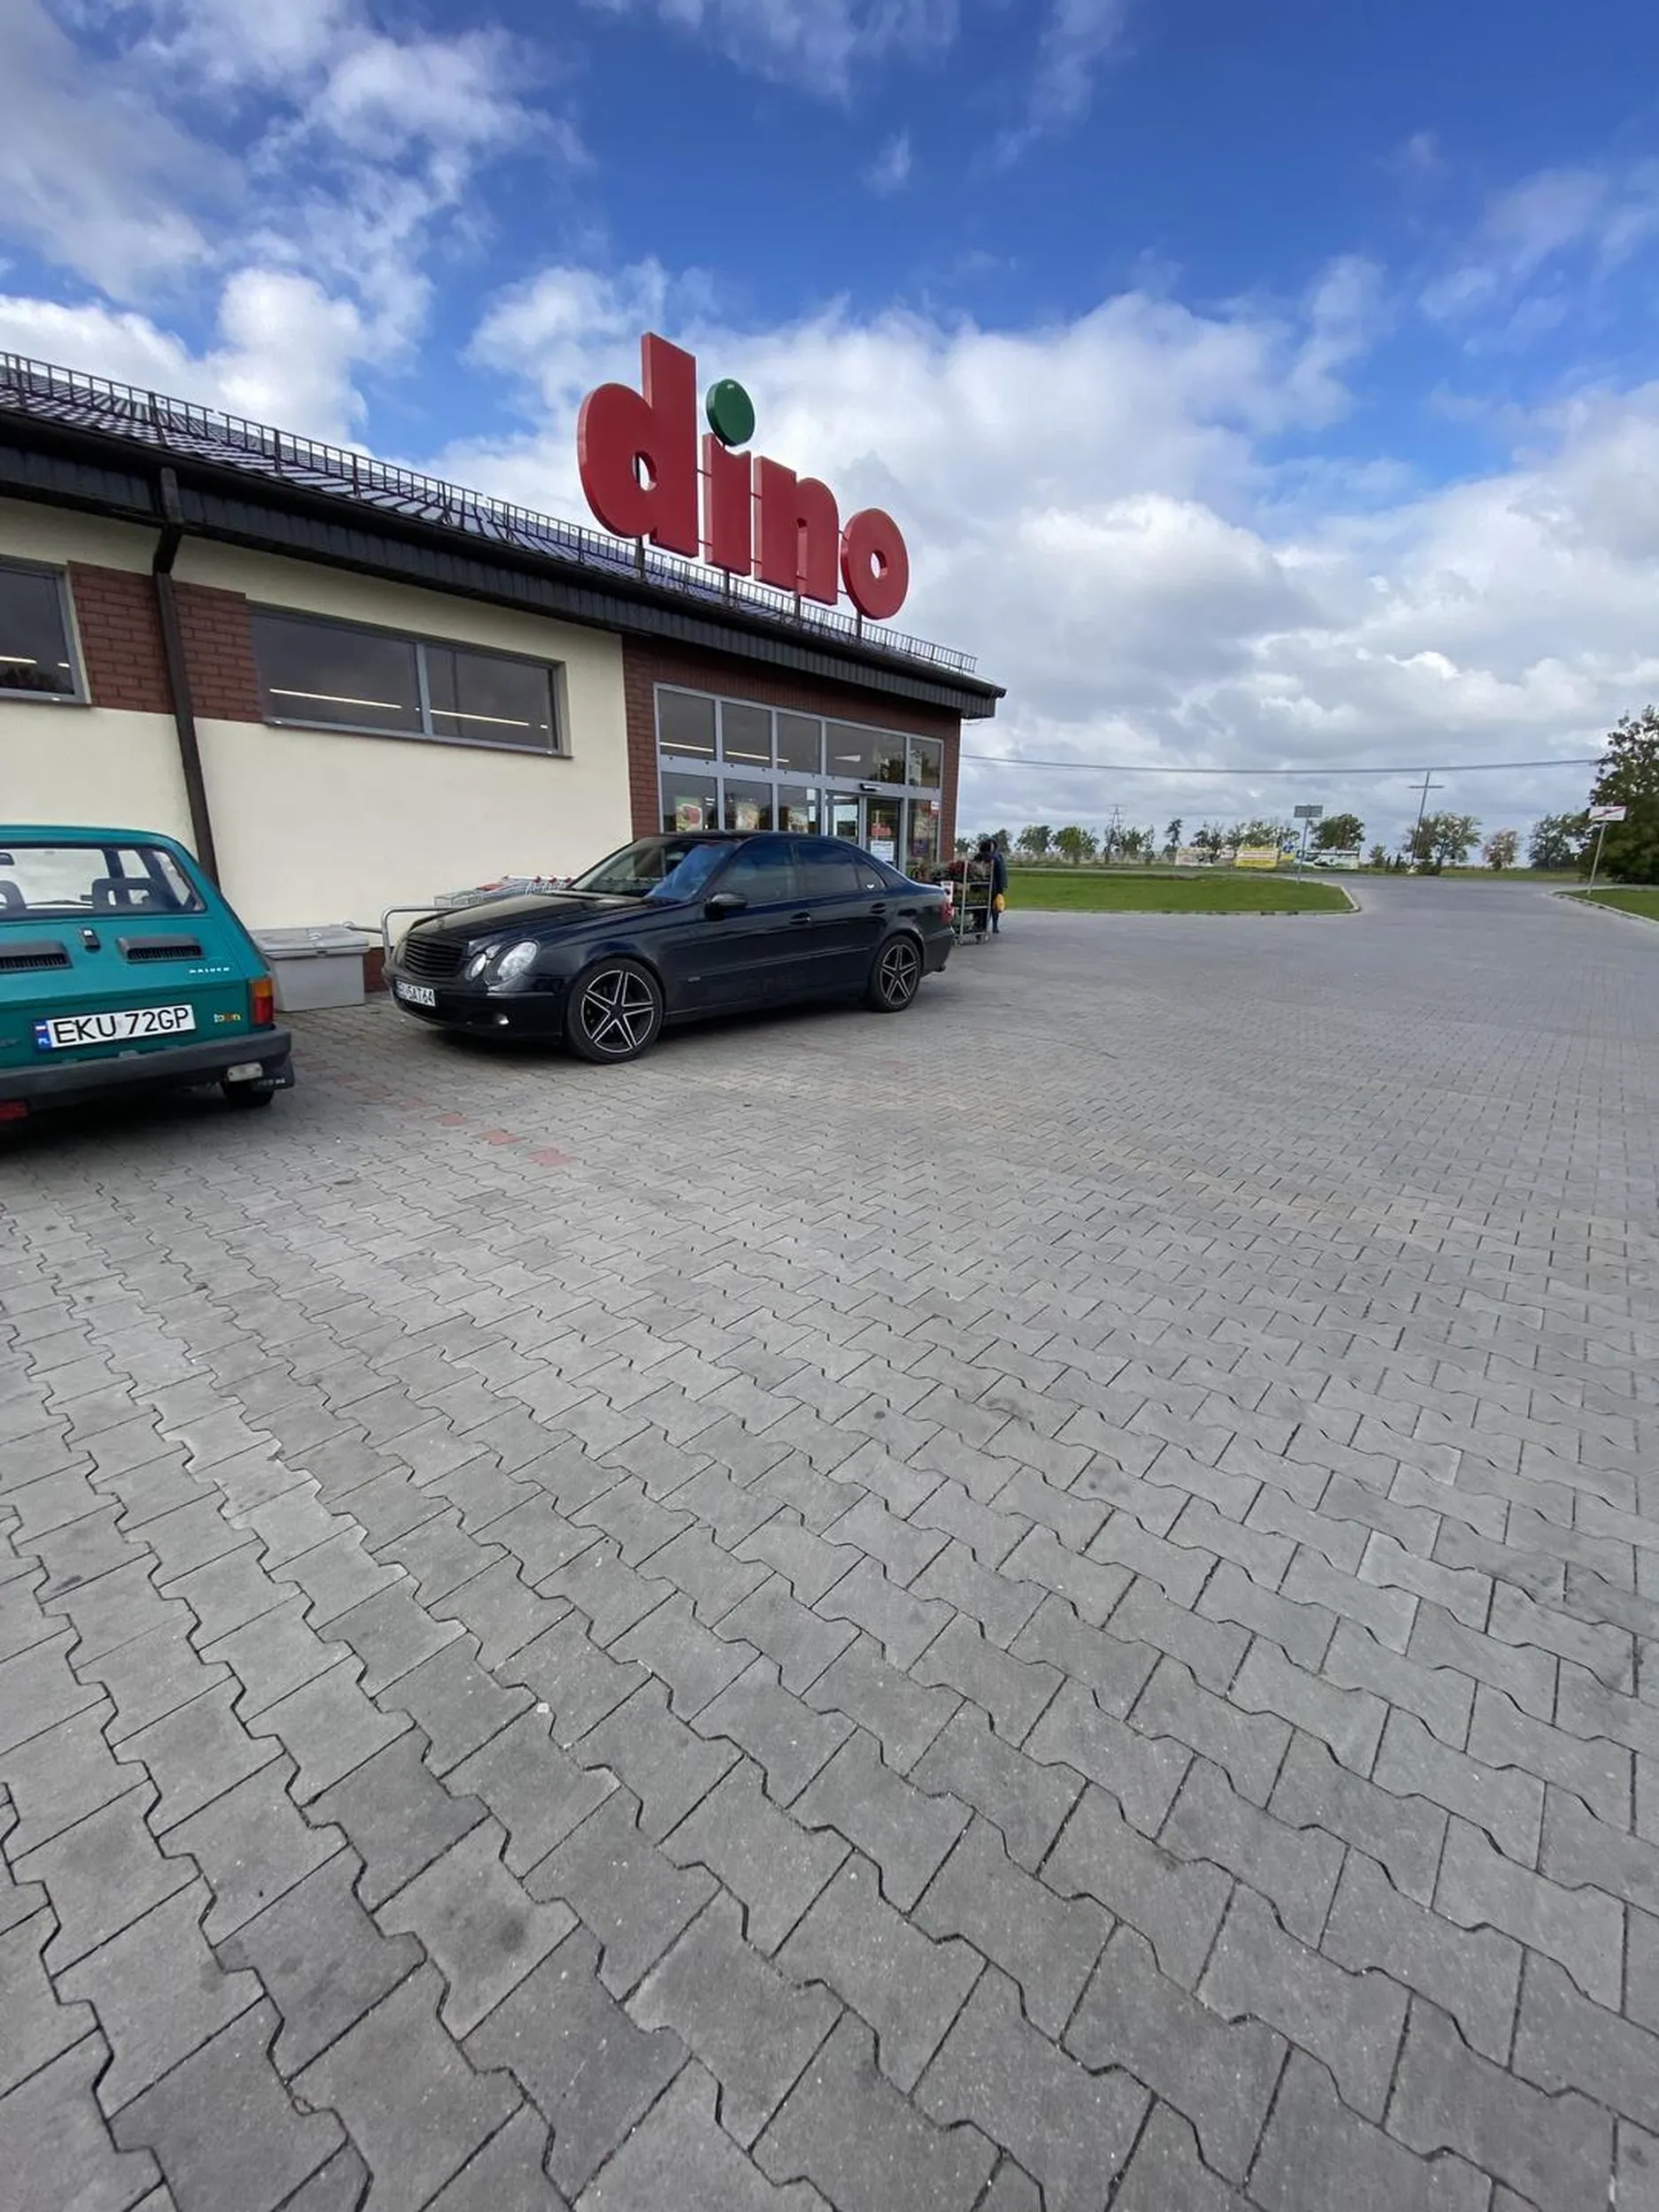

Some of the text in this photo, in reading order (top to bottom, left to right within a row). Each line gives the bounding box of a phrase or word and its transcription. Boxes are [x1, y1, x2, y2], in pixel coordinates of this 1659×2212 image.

[578, 332, 909, 620] dino
[53, 1008, 188, 1044] EKU 72GP
